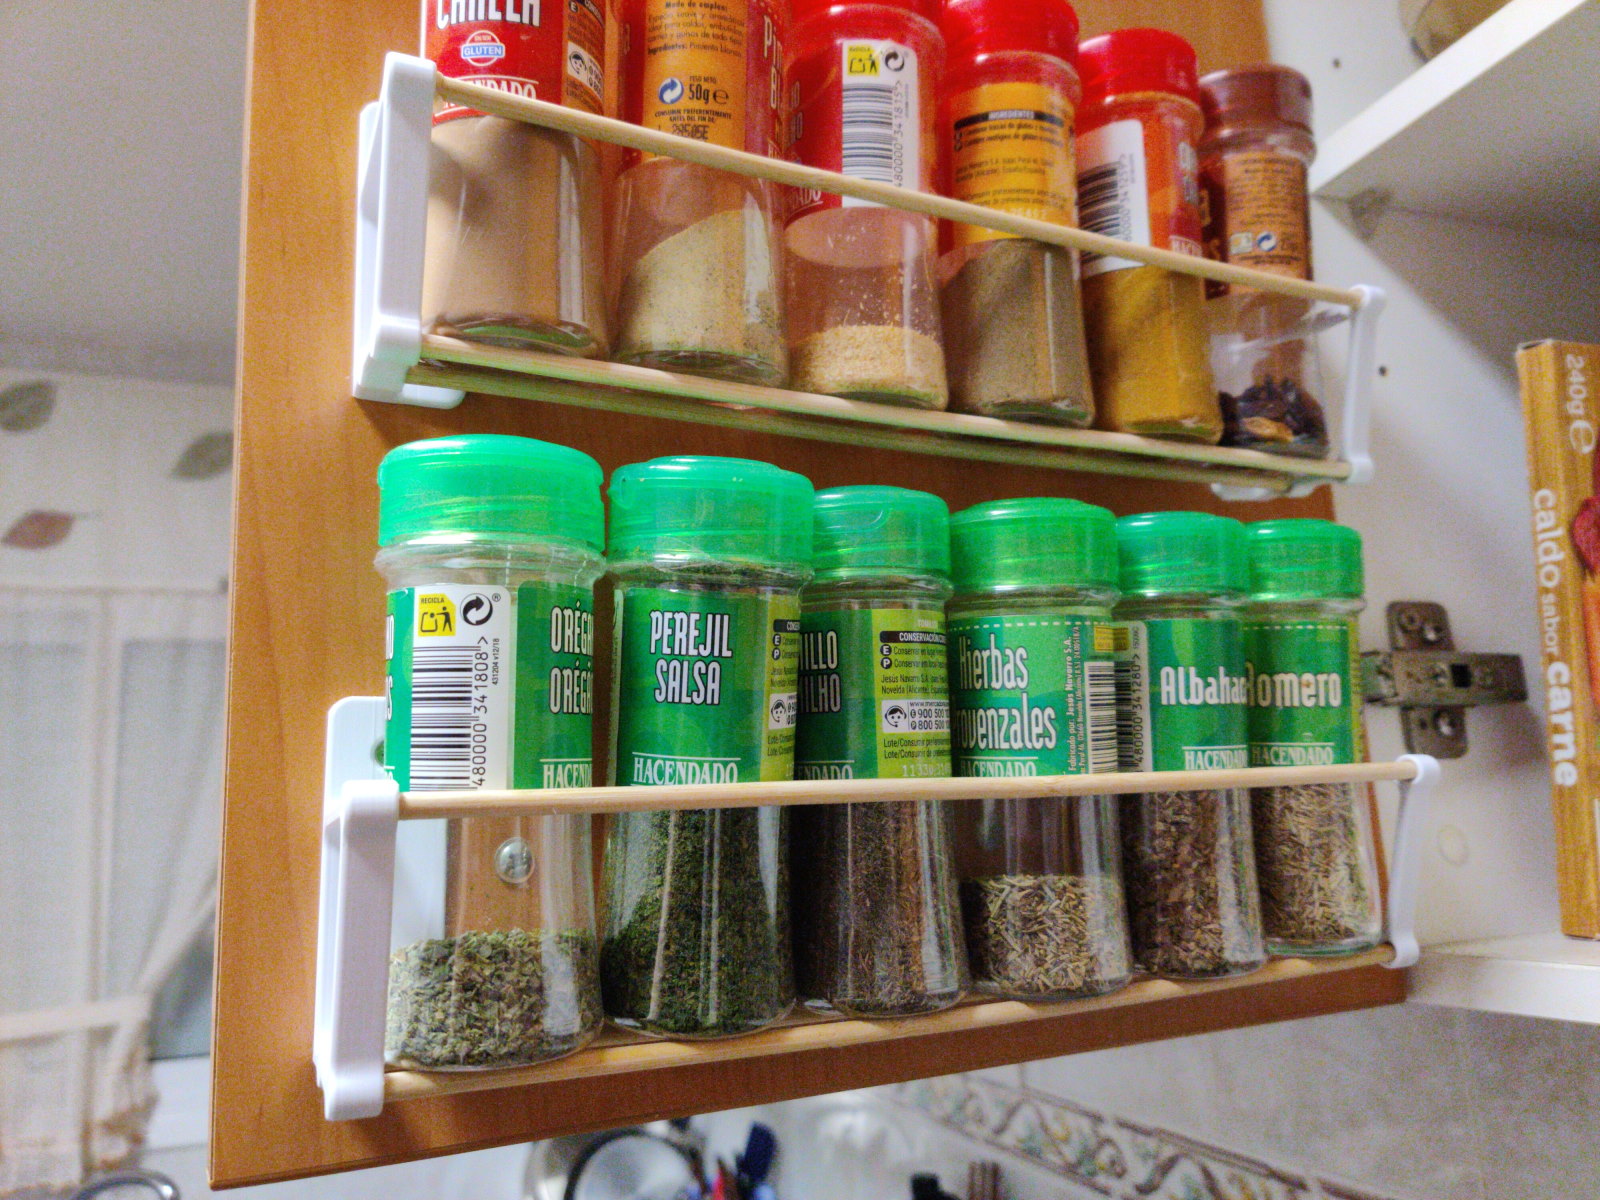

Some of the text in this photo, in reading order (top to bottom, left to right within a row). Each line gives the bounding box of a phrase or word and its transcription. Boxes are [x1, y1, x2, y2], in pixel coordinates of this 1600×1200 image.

[464, 45, 502, 56] GLUTEN
[689, 84, 710, 104] 50g
[1566, 354, 1589, 416] 240g
[420, 597, 446, 605] RECICLA
[650, 609, 734, 657] PEREJIL
[1063, 637, 1072, 654] S.A.
[1534, 488, 1578, 787] caldo sabor carne
[959, 633, 1029, 690] Hierbas
[1064, 656, 1074, 691] Navarro
[654, 658, 722, 706] SALSA
[1131, 664, 1142, 710] 341280
[472, 652, 489, 787] 480000 341808
[918, 708, 932, 719] 900
[1066, 693, 1075, 717] Jesús
[918, 720, 933, 730] 800
[1133, 717, 1145, 763] 480000
[1067, 735, 1078, 771] Fabricado
[633, 757, 739, 785] HACENDADO
